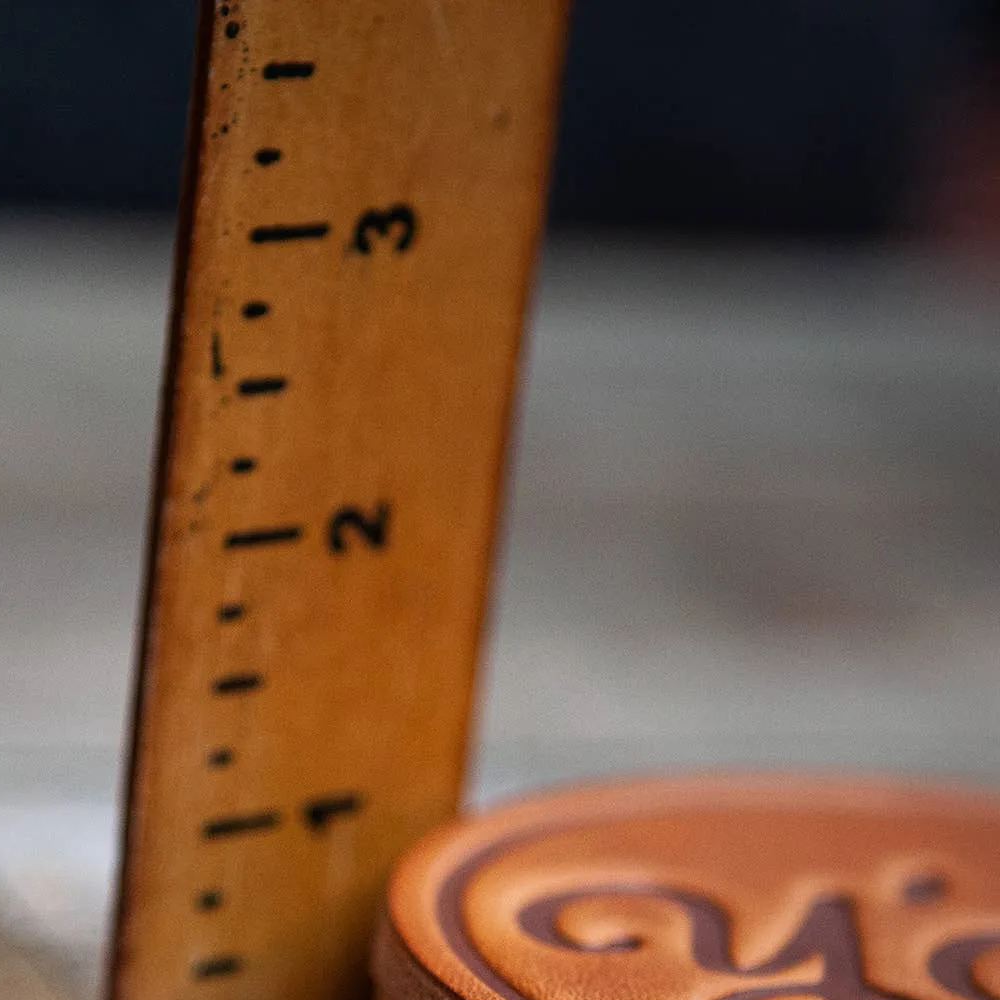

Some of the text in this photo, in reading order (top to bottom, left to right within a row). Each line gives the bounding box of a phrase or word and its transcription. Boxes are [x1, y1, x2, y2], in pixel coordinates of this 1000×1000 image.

[353, 204, 417, 255] 3
[328, 501, 390, 554] 2
[302, 792, 363, 832] 1
